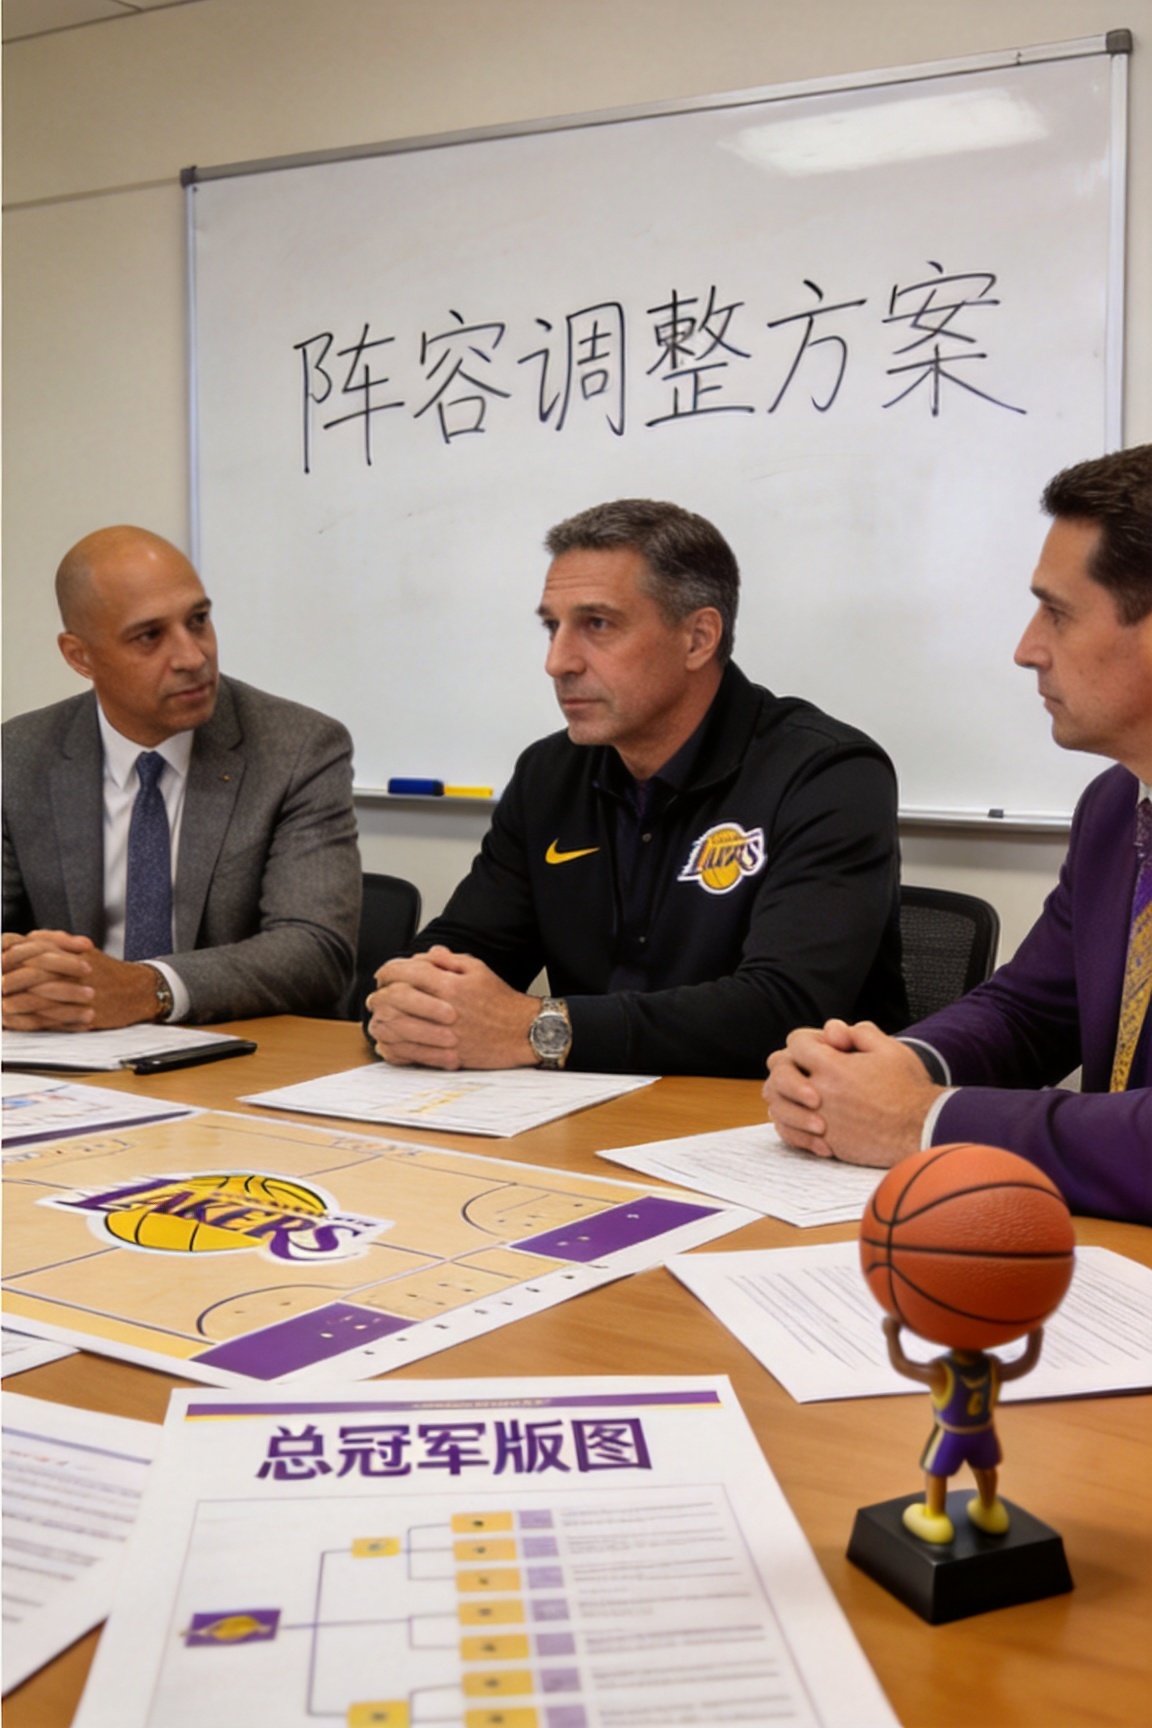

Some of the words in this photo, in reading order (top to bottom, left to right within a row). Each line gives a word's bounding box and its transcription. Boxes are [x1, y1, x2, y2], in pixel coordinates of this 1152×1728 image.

[293, 260, 1028, 474] 阵容调整方案
[56, 1178, 364, 1261] LAKERS
[256, 1417, 653, 1481] 总冠军版图
